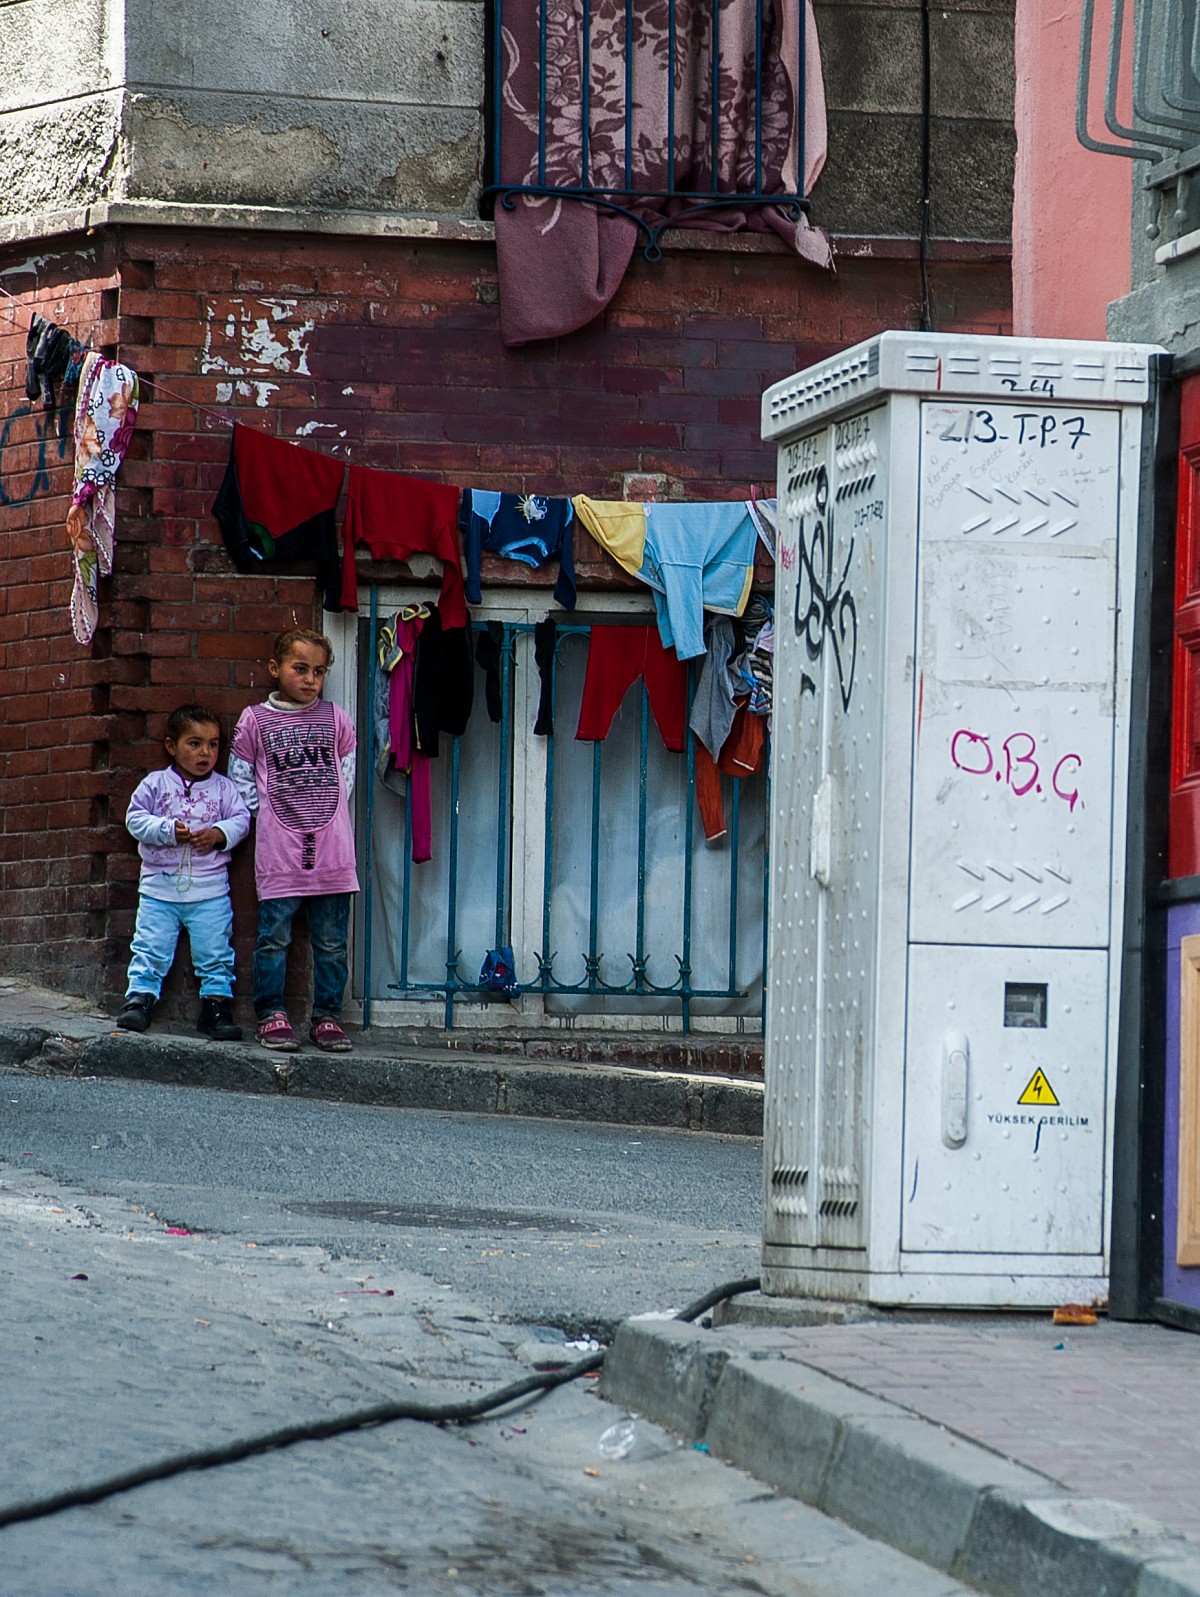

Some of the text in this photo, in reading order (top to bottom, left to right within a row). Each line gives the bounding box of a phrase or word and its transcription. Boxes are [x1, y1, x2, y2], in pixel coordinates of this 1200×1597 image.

[1001, 379, 1054, 398] 264
[272, 745, 333, 773] LOVE
[987, 1113, 1089, 1126] YÜKSEK GERİLİM
